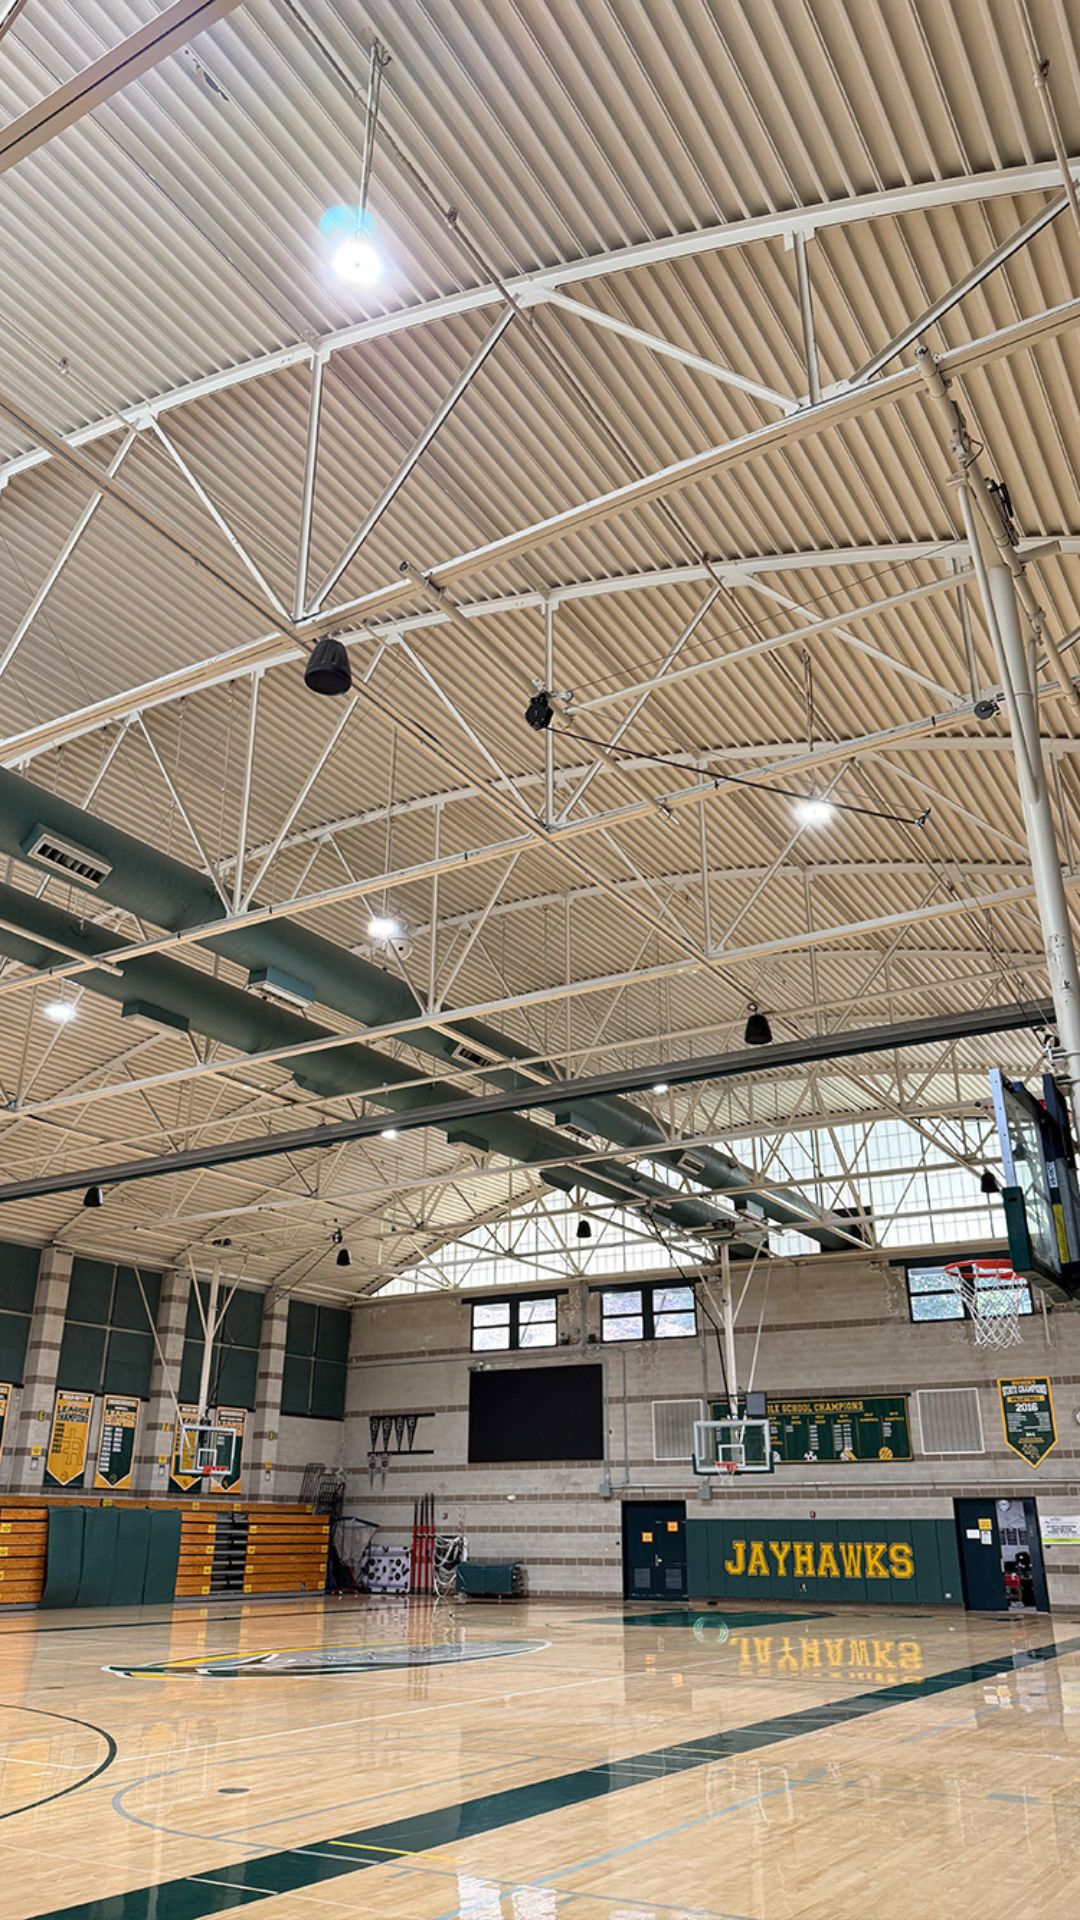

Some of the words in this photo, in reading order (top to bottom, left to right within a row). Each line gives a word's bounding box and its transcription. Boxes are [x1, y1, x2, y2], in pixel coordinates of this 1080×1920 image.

[57, 1405, 90, 1414] LEAGUE
[782, 1403, 812, 1413] SCHOOL
[813, 1400, 864, 1412] CHAMPIONS
[1015, 1403, 1039, 1412] 2016
[724, 1540, 915, 1579] JAYHAWKS
